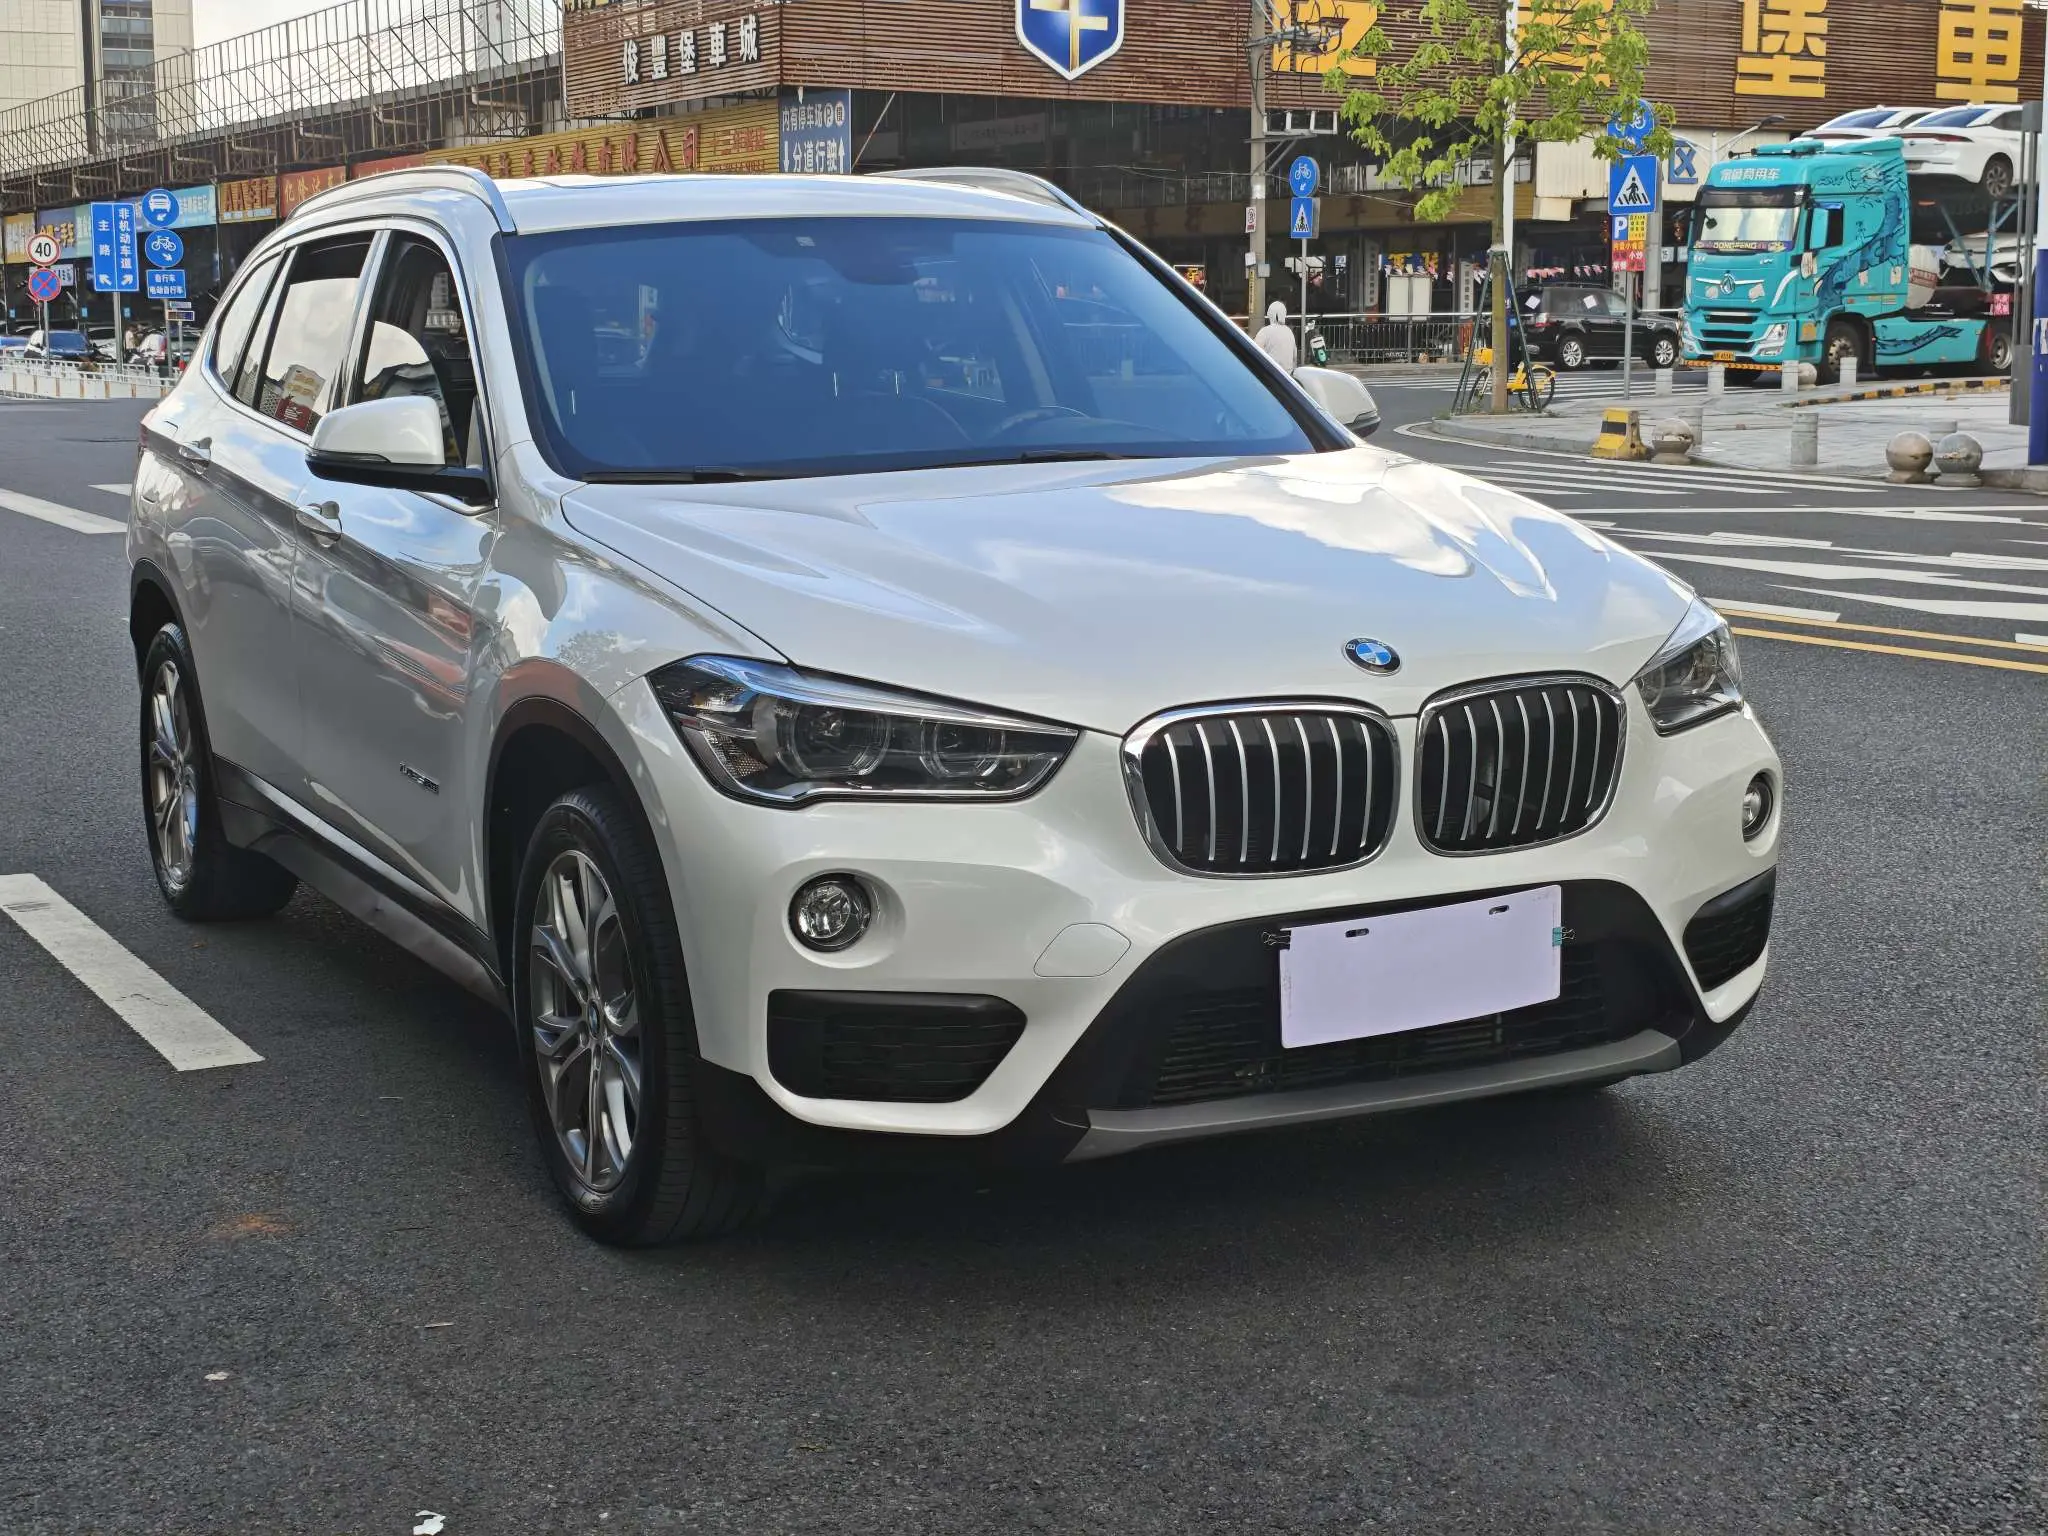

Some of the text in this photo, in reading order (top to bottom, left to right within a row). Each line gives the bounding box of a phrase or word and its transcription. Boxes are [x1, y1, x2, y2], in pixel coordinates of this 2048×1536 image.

[98, 219, 111, 256] 主路
[118, 207, 132, 268] 非机动车道
[35, 242, 52, 257] 40
[154, 273, 176, 282] 自行车
[149, 285, 184, 294] 电动自行车
